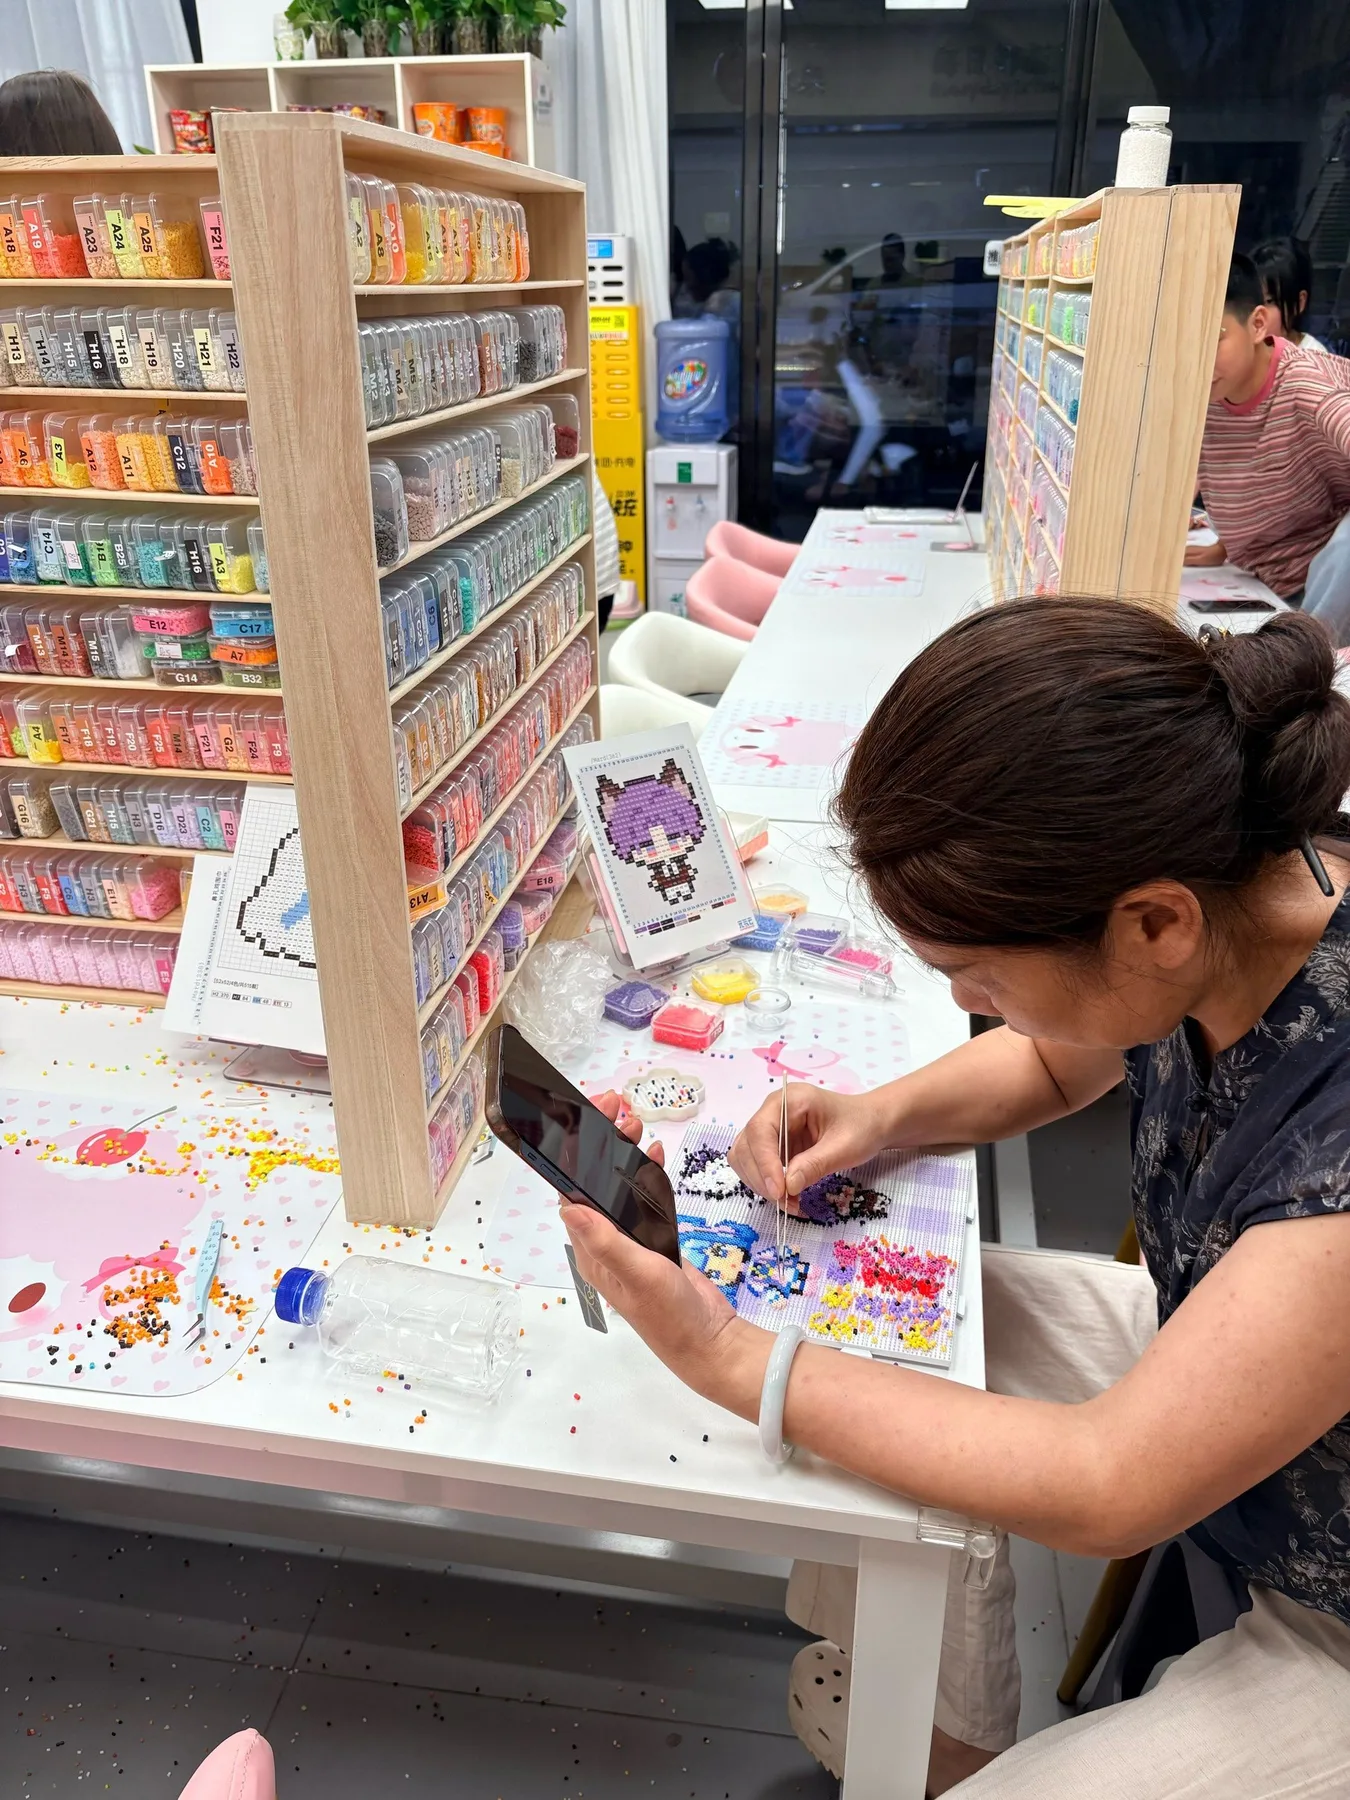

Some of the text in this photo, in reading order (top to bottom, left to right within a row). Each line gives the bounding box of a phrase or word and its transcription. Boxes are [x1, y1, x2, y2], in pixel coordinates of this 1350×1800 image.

[3, 227, 16, 253] A18
[28, 223, 43, 249] A19
[83, 227, 97, 253] A23
[111, 223, 125, 249] A24
[139, 226, 152, 253] A25
[210, 226, 224, 251] F21
[356, 222, 363, 247] A2
[376, 233, 384, 258] A8
[8, 335, 21, 361] H13
[35, 340, 50, 365] H14
[62, 341, 77, 368] H15
[88, 343, 103, 370] H16
[114, 339, 128, 365] H18
[144, 341, 158, 367] H19
[171, 342, 185, 369] H20
[199, 341, 211, 367] H21
[226, 342, 240, 369] H22
[396, 369, 403, 395] M4
[409, 359, 416, 384] M5
[370, 373, 378, 400] M2
[18, 449, 29, 466] A6
[54, 443, 63, 461] A3
[85, 448, 97, 472] A12
[173, 446, 186, 470] C12
[205, 444, 219, 468] A10
[122, 455, 135, 478] A11
[43, 532, 54, 554] C14
[114, 543, 127, 567] B25
[188, 550, 202, 574] H16
[215, 557, 226, 574] A3
[149, 620, 167, 631] E12
[428, 605, 436, 626] C6
[239, 624, 262, 634] C17
[416, 620, 424, 647] C20
[32, 634, 46, 657] M13
[57, 635, 69, 657] M14
[88, 640, 100, 661] M15
[230, 650, 244, 661] A7
[175, 673, 198, 683] G14
[241, 673, 262, 684] B32
[32, 726, 43, 741] A4
[59, 726, 71, 745] F17
[80, 727, 94, 747] F18
[105, 727, 117, 747] F19
[125, 732, 137, 752] F20
[151, 734, 165, 753] F25
[172, 733, 183, 754] M14
[200, 735, 211, 753] F21
[223, 737, 234, 753] G2
[247, 740, 259, 759] F24
[271, 743, 282, 757] F9
[17, 804, 30, 824] G16
[85, 809, 96, 828] G21
[107, 809, 119, 830] H15
[130, 812, 142, 828] H3
[152, 812, 163, 831] D16
[176, 815, 188, 835] D23
[200, 818, 211, 833] C2
[224, 821, 235, 837] E2
[18, 884, 29, 898] H3
[537, 876, 554, 886] E18
[63, 886, 73, 900] C6
[85, 887, 95, 902] H3
[106, 888, 118, 905] E11
[408, 891, 429, 909] A13
[160, 971, 169, 984] E5
